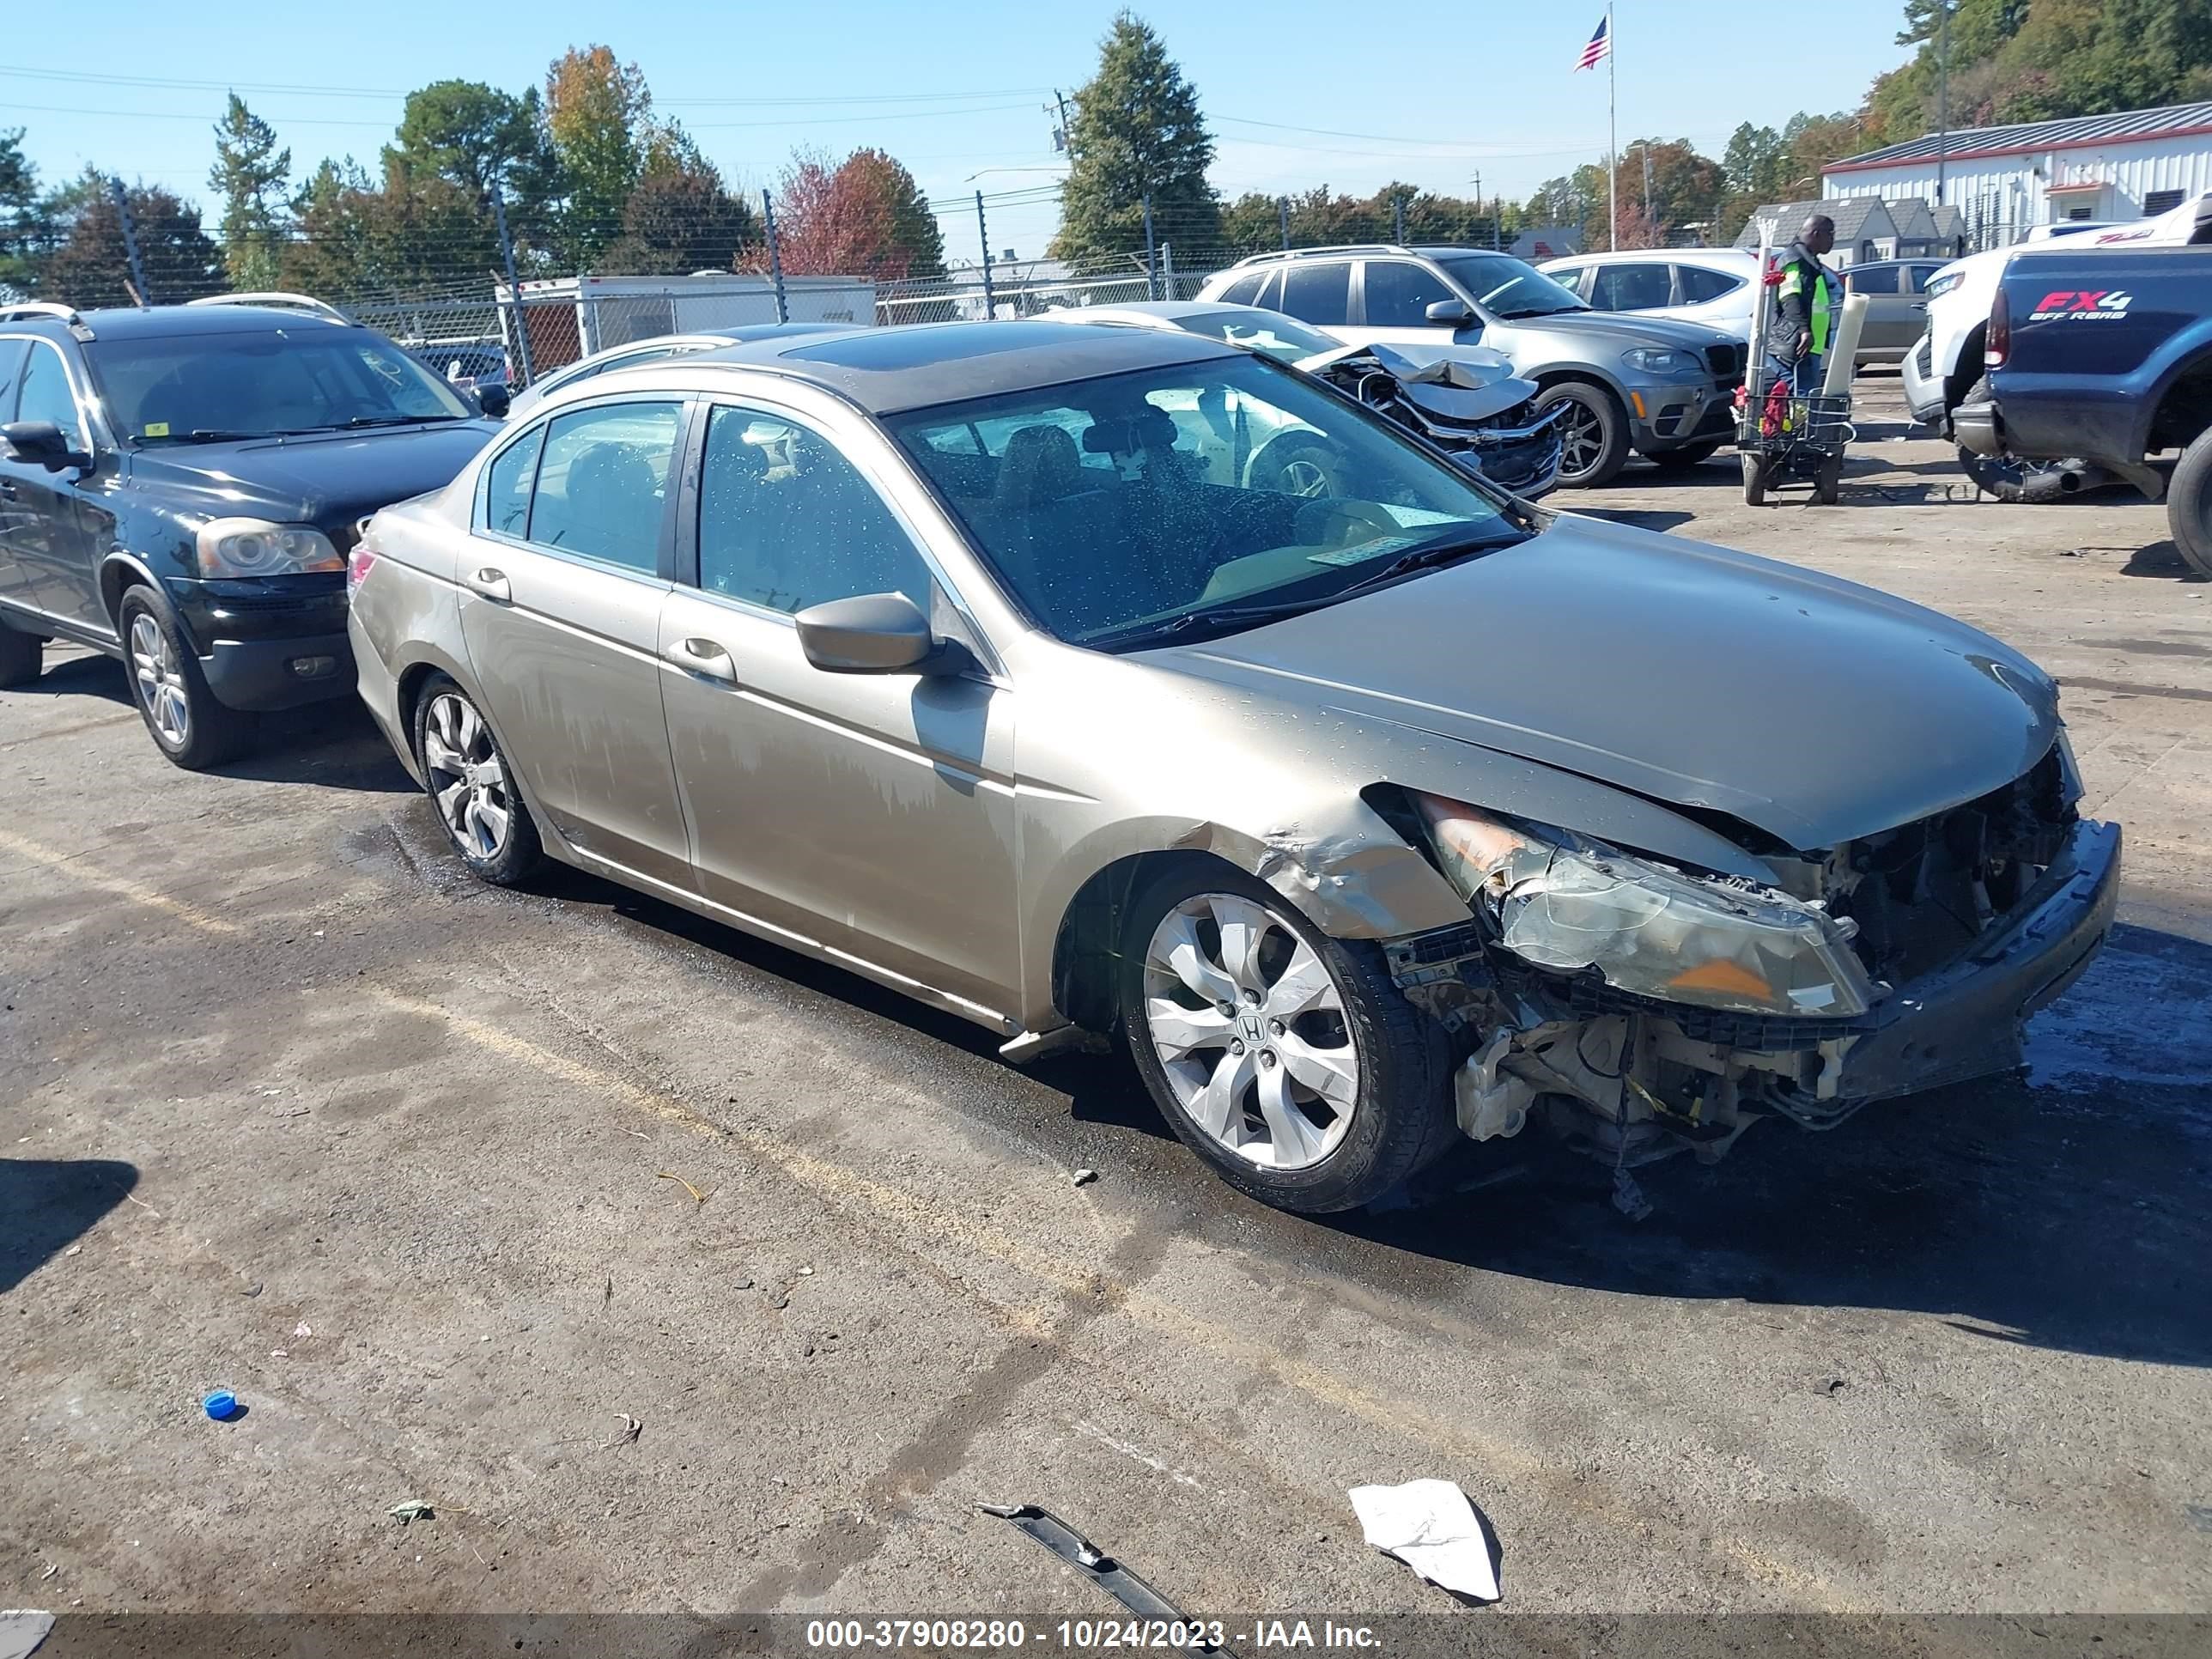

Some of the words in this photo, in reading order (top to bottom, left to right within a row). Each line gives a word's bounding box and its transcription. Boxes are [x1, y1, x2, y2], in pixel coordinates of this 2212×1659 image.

[2034, 290, 2133, 312] FX4
[2028, 312, 2068, 321] OFF
[2069, 311, 2128, 320] ROAD
